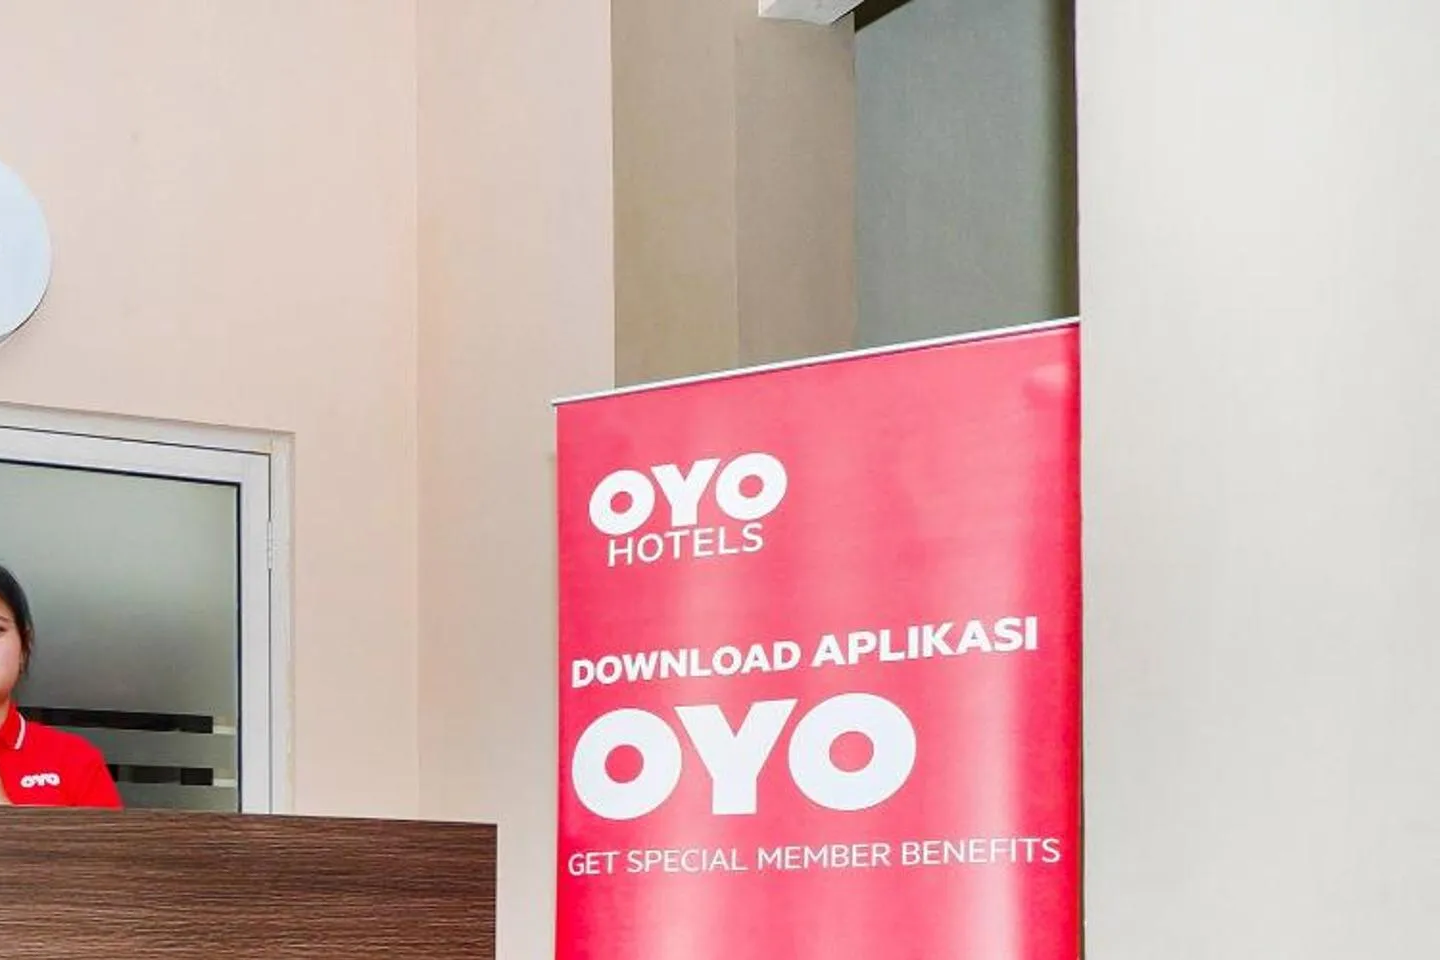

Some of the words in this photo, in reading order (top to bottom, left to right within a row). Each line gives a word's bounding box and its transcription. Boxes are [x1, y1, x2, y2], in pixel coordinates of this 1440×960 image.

[588, 452, 788, 535] OYO
[607, 523, 764, 567] HOTELS
[571, 640, 801, 688] DOWNLOAD
[812, 616, 1038, 668] APLIKASI
[21, 773, 60, 788] OYO
[571, 692, 917, 820] OYO
[568, 851, 619, 876] GET
[627, 848, 748, 874] SPECIAL
[757, 842, 891, 871] MEMBER
[901, 838, 1061, 866] BENEFITS
